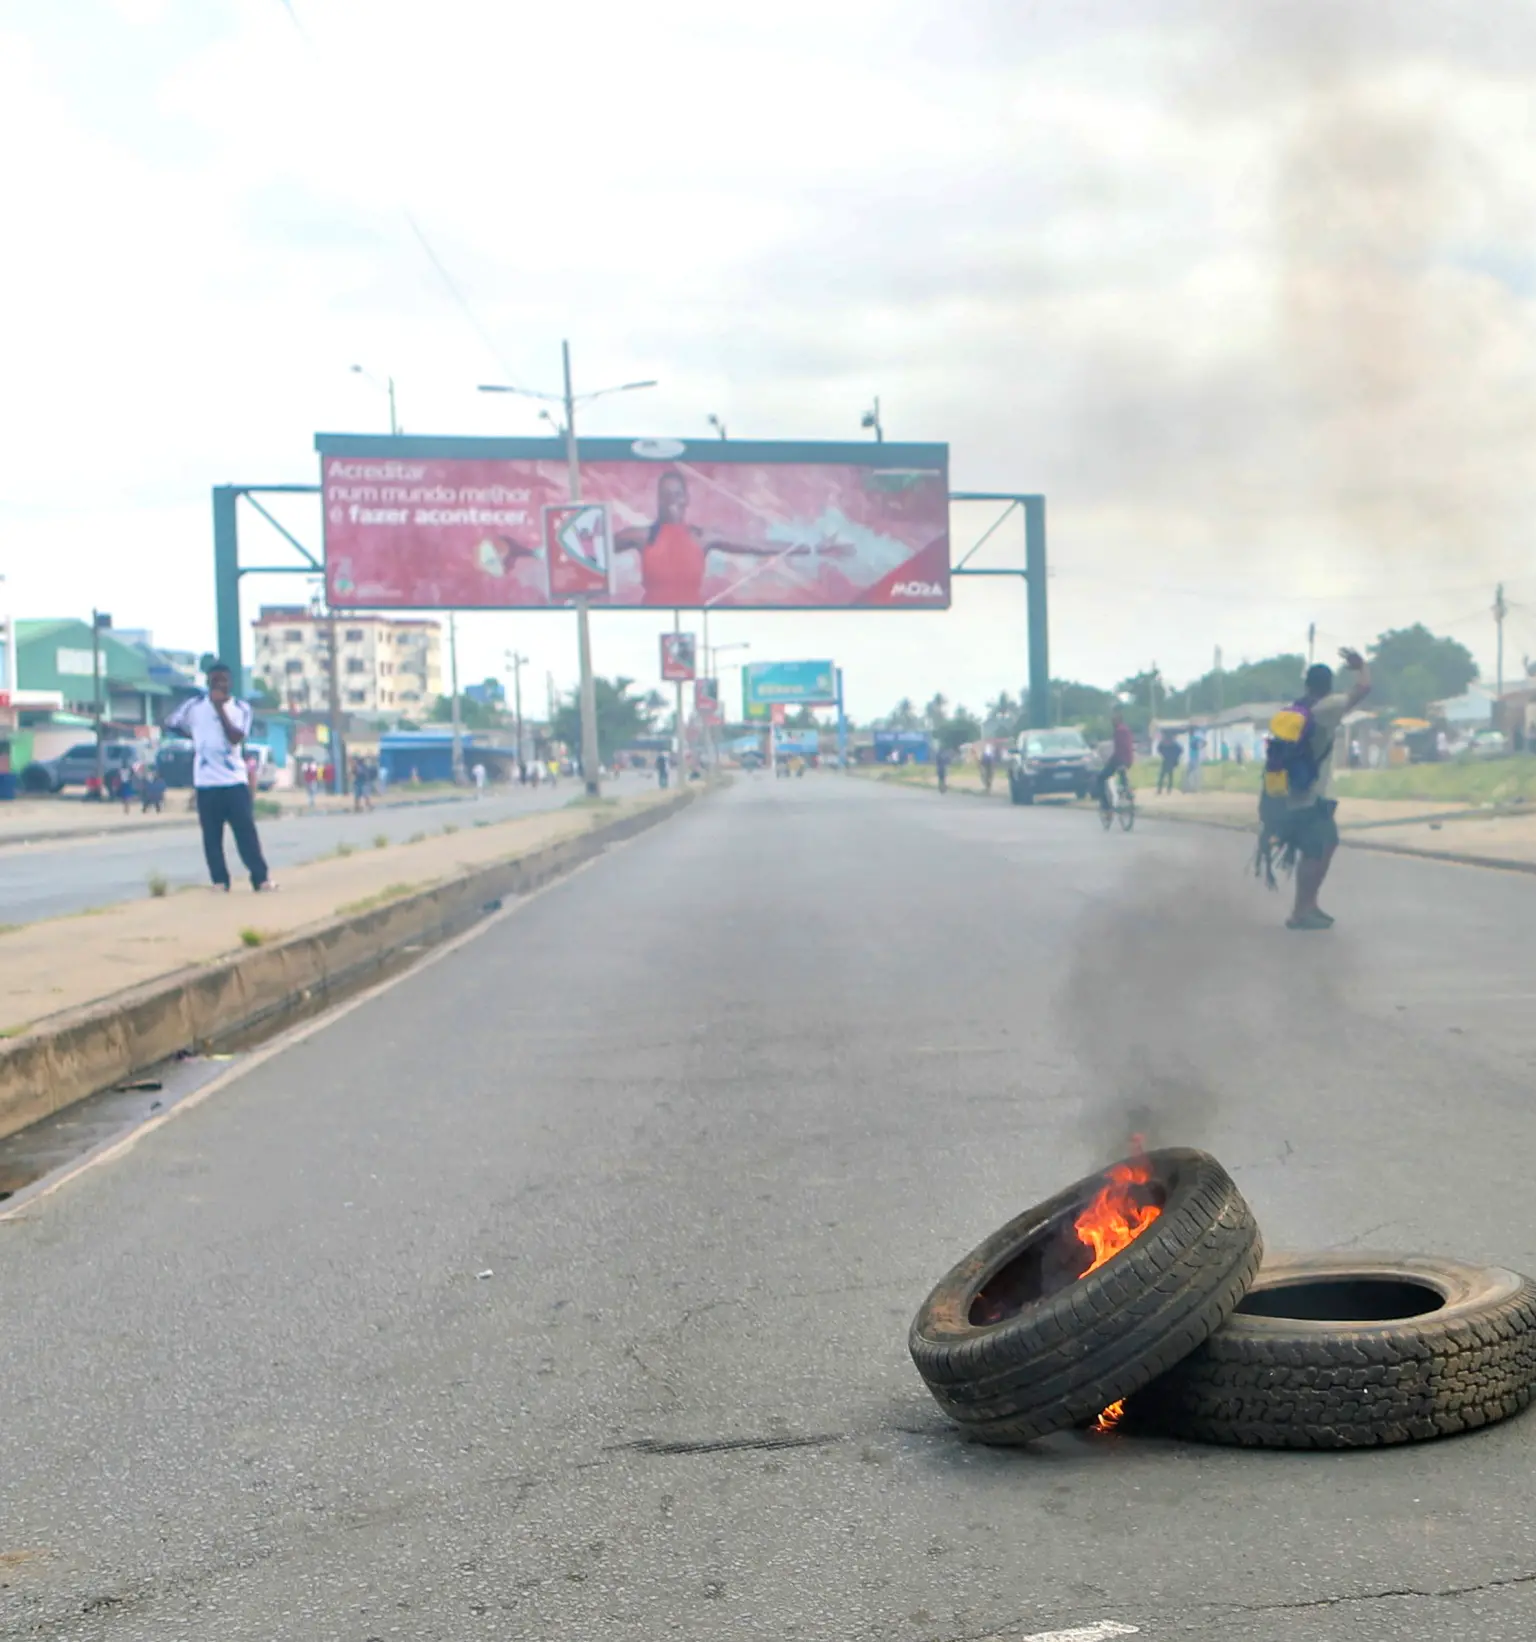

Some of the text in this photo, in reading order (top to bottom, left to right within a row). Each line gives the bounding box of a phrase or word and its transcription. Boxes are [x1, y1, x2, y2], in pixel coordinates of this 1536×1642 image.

[329, 461, 427, 479] Acreditar
[328, 484, 531, 503] num mundo melhor
[349, 503, 409, 524] fazer
[414, 506, 535, 525] acontecer.
